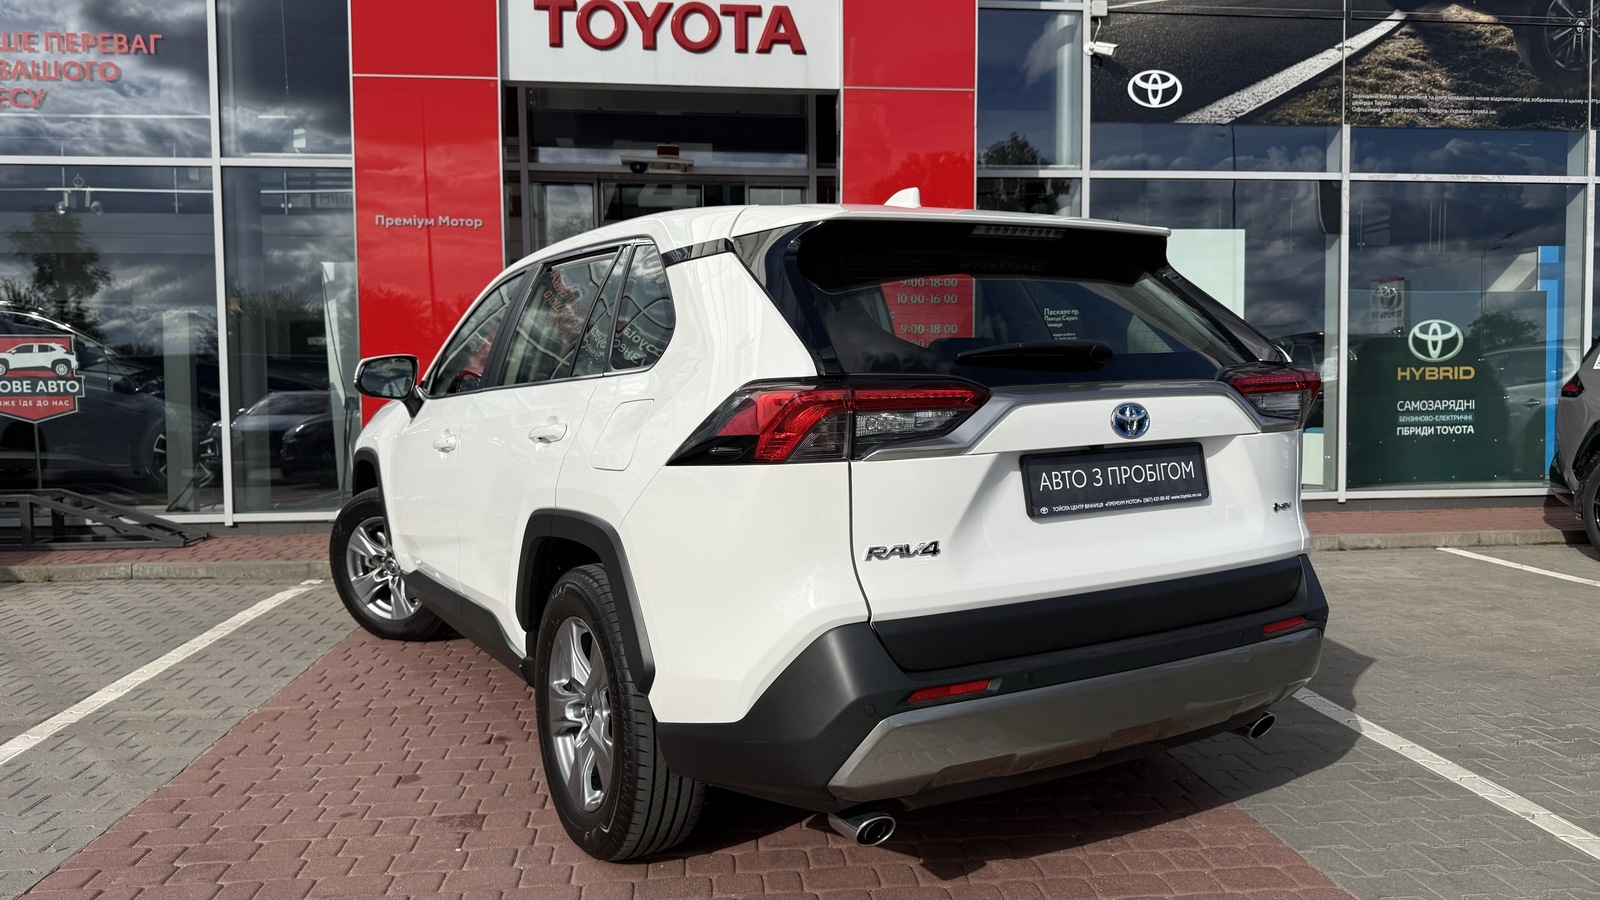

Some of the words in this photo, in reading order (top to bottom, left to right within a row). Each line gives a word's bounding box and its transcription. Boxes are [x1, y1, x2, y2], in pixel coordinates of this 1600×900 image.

[534, 0, 807, 55] TOYOTA
[45, 32, 162, 54] ПЕРЕВАГ
[375, 215, 434, 228] Преміум
[438, 216, 482, 229] Мотор
[1397, 366, 1476, 381] HYBRID
[36, 380, 80, 393] АВТО
[1397, 400, 1475, 412] САМОЗАРЯДНІ
[1399, 414, 1472, 422] БЕНЗИНОВО-ЕЛЕКТРИЧНІ
[1397, 427, 1434, 436] ГІБРИДИ
[1436, 426, 1474, 435] TOYOTA
[1040, 470, 1087, 492] АВТО
[1092, 468, 1103, 487] З
[1108, 460, 1195, 486] ПРОБІГОМ
[864, 540, 941, 562] RAV4
